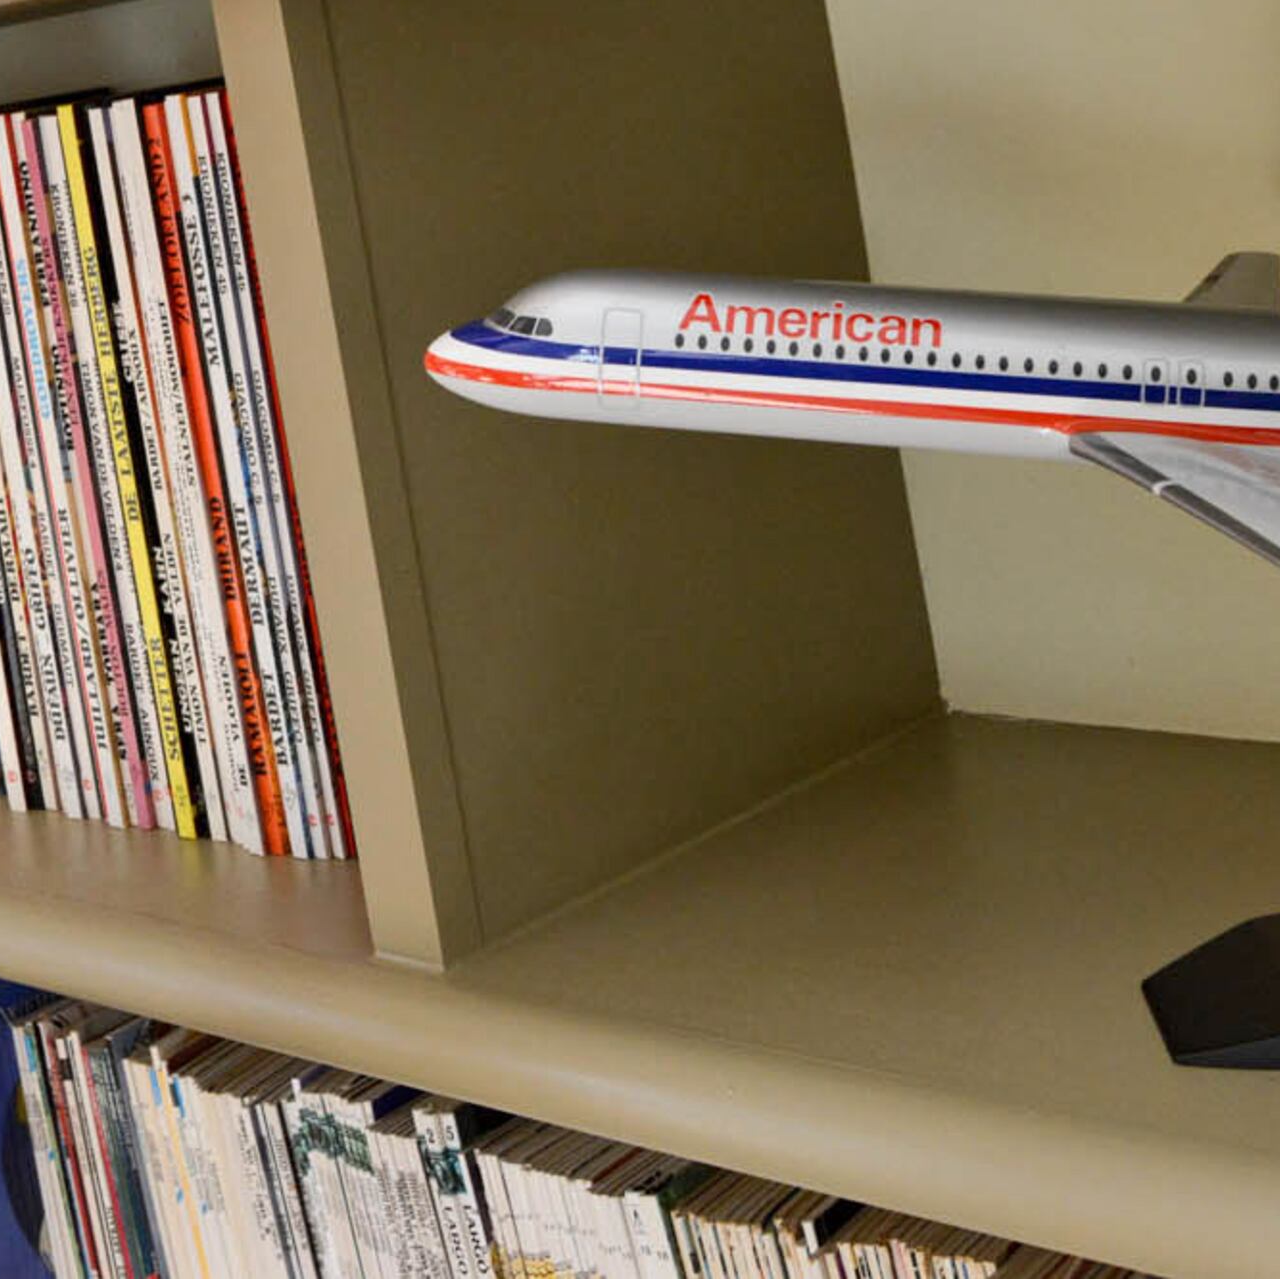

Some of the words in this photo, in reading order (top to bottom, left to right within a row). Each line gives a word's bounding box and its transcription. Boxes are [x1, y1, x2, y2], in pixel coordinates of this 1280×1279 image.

[215, 151, 243, 266] KRONIEKEN
[82, 245, 112, 356] HERBERG
[184, 214, 221, 367] MALEFOSSE
[197, 154, 224, 268] KRONIEKEN
[234, 371, 257, 467] GIACOMO
[678, 292, 943, 348] American
[80, 361, 97, 418] TIMON
[90, 421, 104, 460] VAN
[102, 488, 121, 559] VELDEN
[104, 369, 132, 476] LAATSTE
[125, 494, 139, 522] DE
[232, 499, 265, 627] DERMAUT
[40, 652, 66, 740] DUFAUX
[149, 636, 181, 762] SCHETTER
[188, 683, 207, 744] TIMON
[261, 667, 288, 766] BARDET
[426, 1128, 436, 1144] 2
[442, 1205, 468, 1276] LARGO
[445, 1125, 456, 1142] 5
[463, 1204, 490, 1274] LARGO
